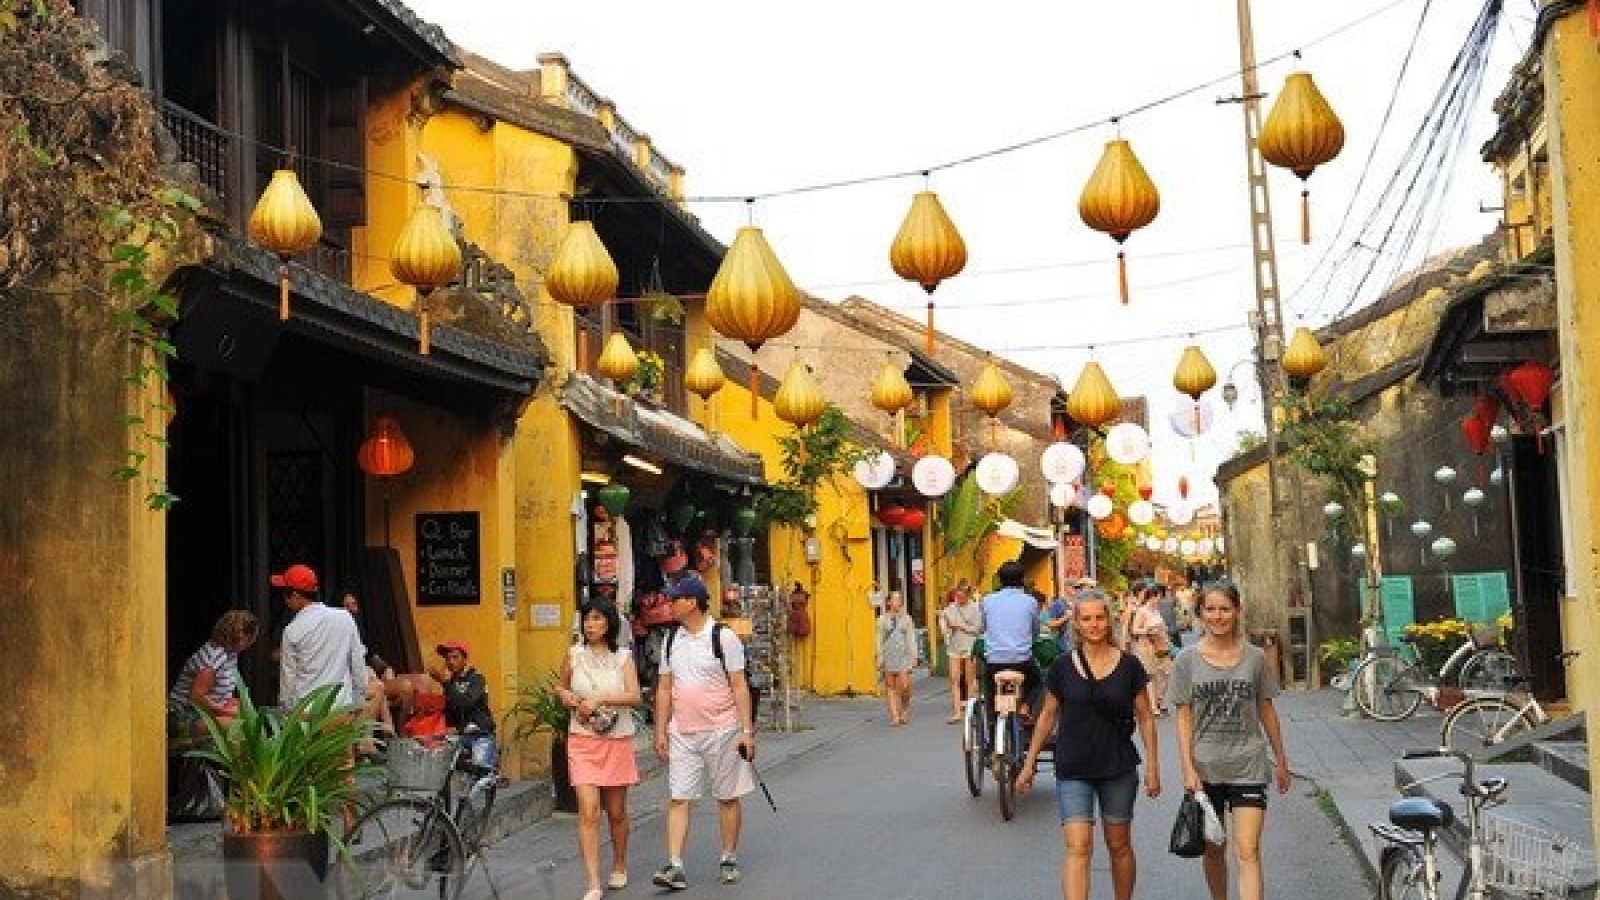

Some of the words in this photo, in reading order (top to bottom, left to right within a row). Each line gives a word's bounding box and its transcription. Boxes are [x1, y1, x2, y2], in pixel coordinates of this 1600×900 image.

[449, 521, 473, 540] Bar
[426, 542, 467, 560] Lunch
[429, 561, 471, 579] Dinner
